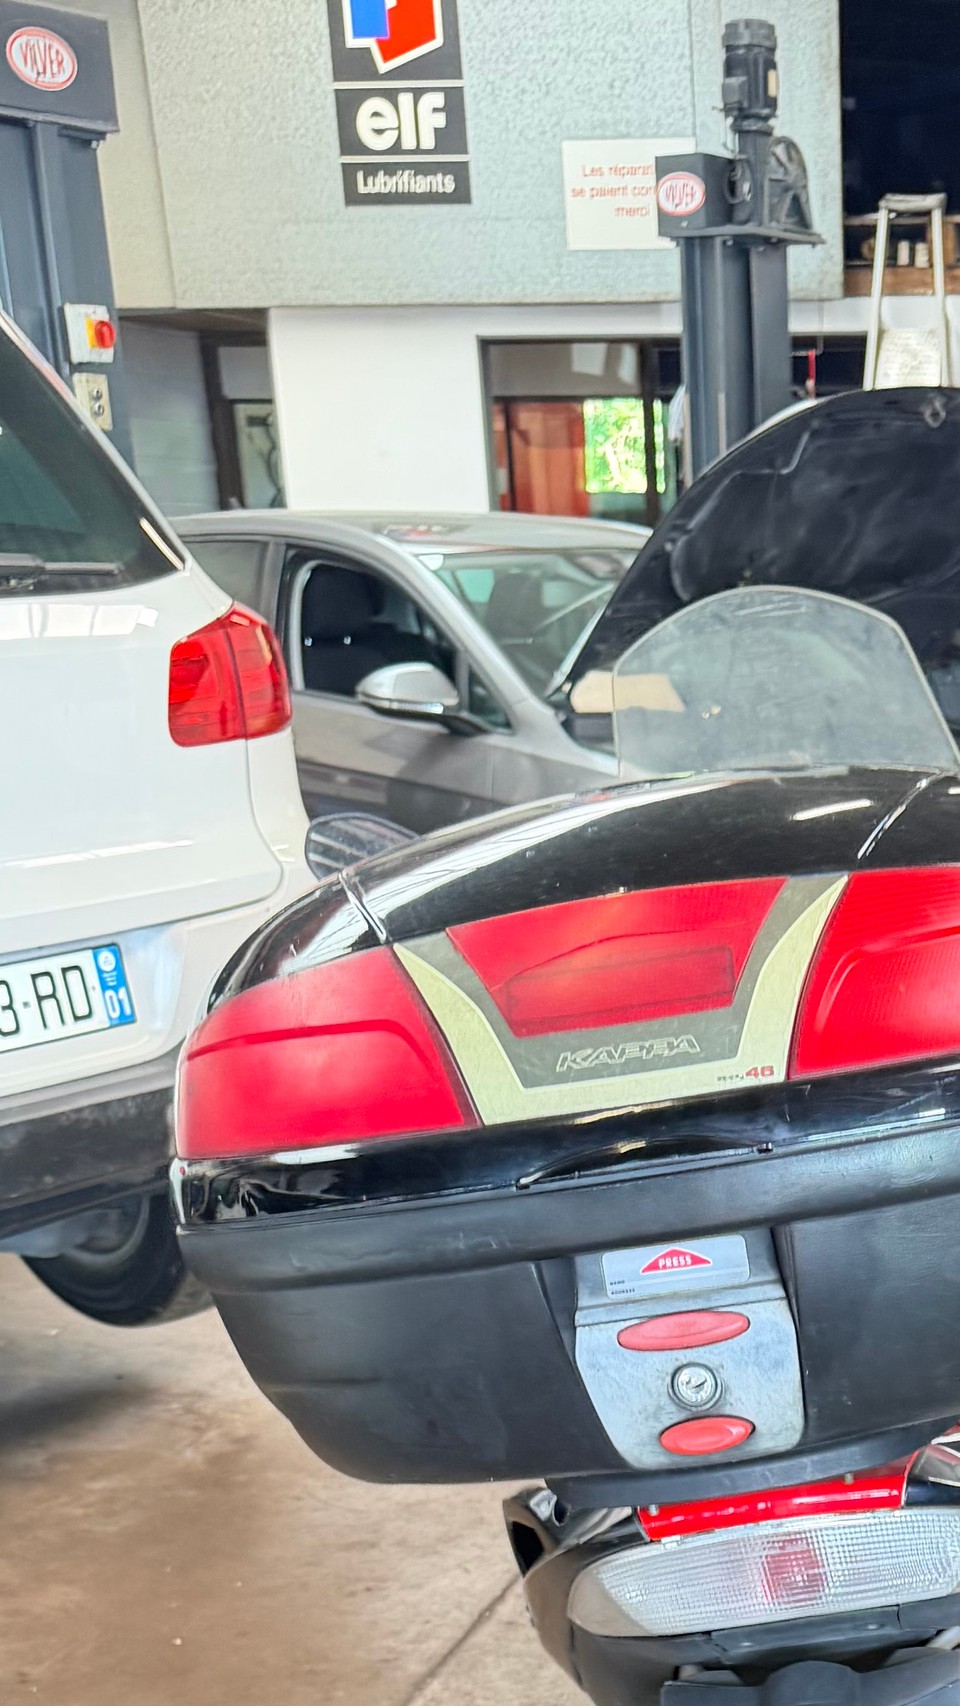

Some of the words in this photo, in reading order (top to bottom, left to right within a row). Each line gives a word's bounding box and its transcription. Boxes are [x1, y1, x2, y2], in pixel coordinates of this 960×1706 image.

[356, 91, 447, 151] elf
[356, 169, 455, 194] Lubrifiants
[105, 986, 132, 1019] 01
[658, 1255, 692, 1269] PRESS
